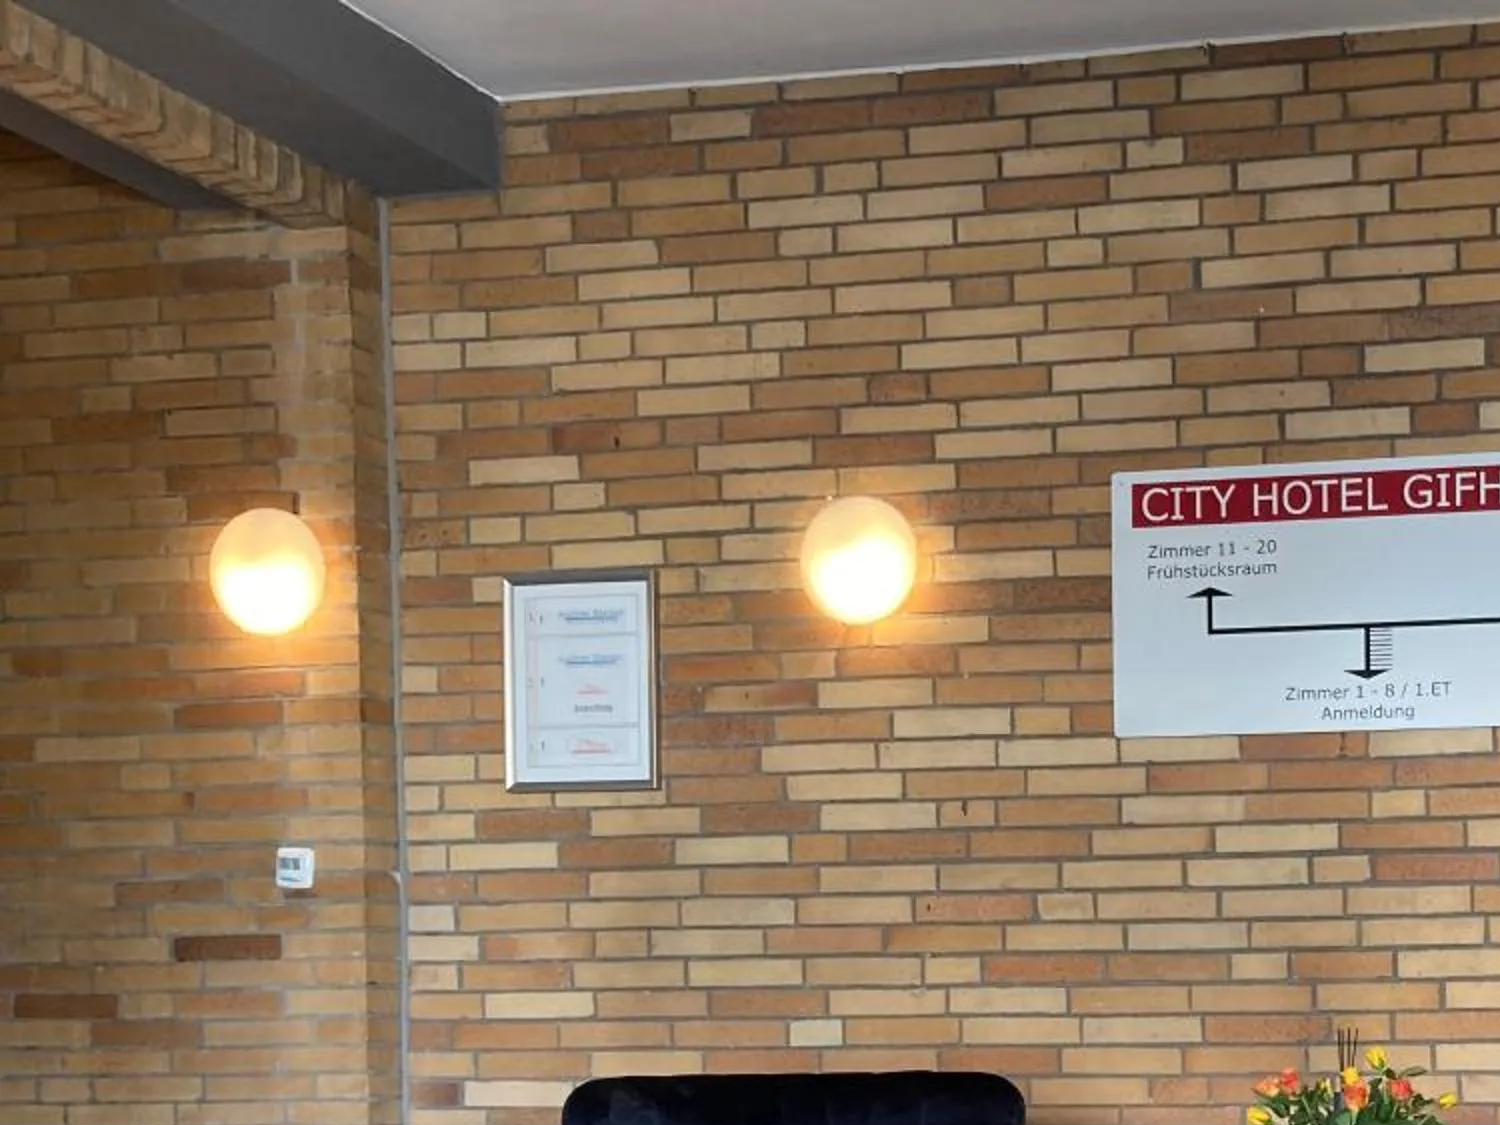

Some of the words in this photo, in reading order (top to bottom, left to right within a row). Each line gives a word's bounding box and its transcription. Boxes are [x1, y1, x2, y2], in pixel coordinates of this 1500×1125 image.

[1141, 484, 1236, 521] CITY
[1253, 476, 1389, 517] HOTEL
[1147, 544, 1211, 559] Zimmer
[1218, 541, 1236, 556] 11
[1257, 539, 1278, 555] 20
[1147, 561, 1278, 580] Frühstücksraum
[1285, 686, 1350, 701] Zimmer
[1356, 684, 1364, 699] 1
[1384, 683, 1396, 698] 8
[1414, 681, 1451, 698] 1.ET
[1321, 704, 1416, 720] Anmeldung
